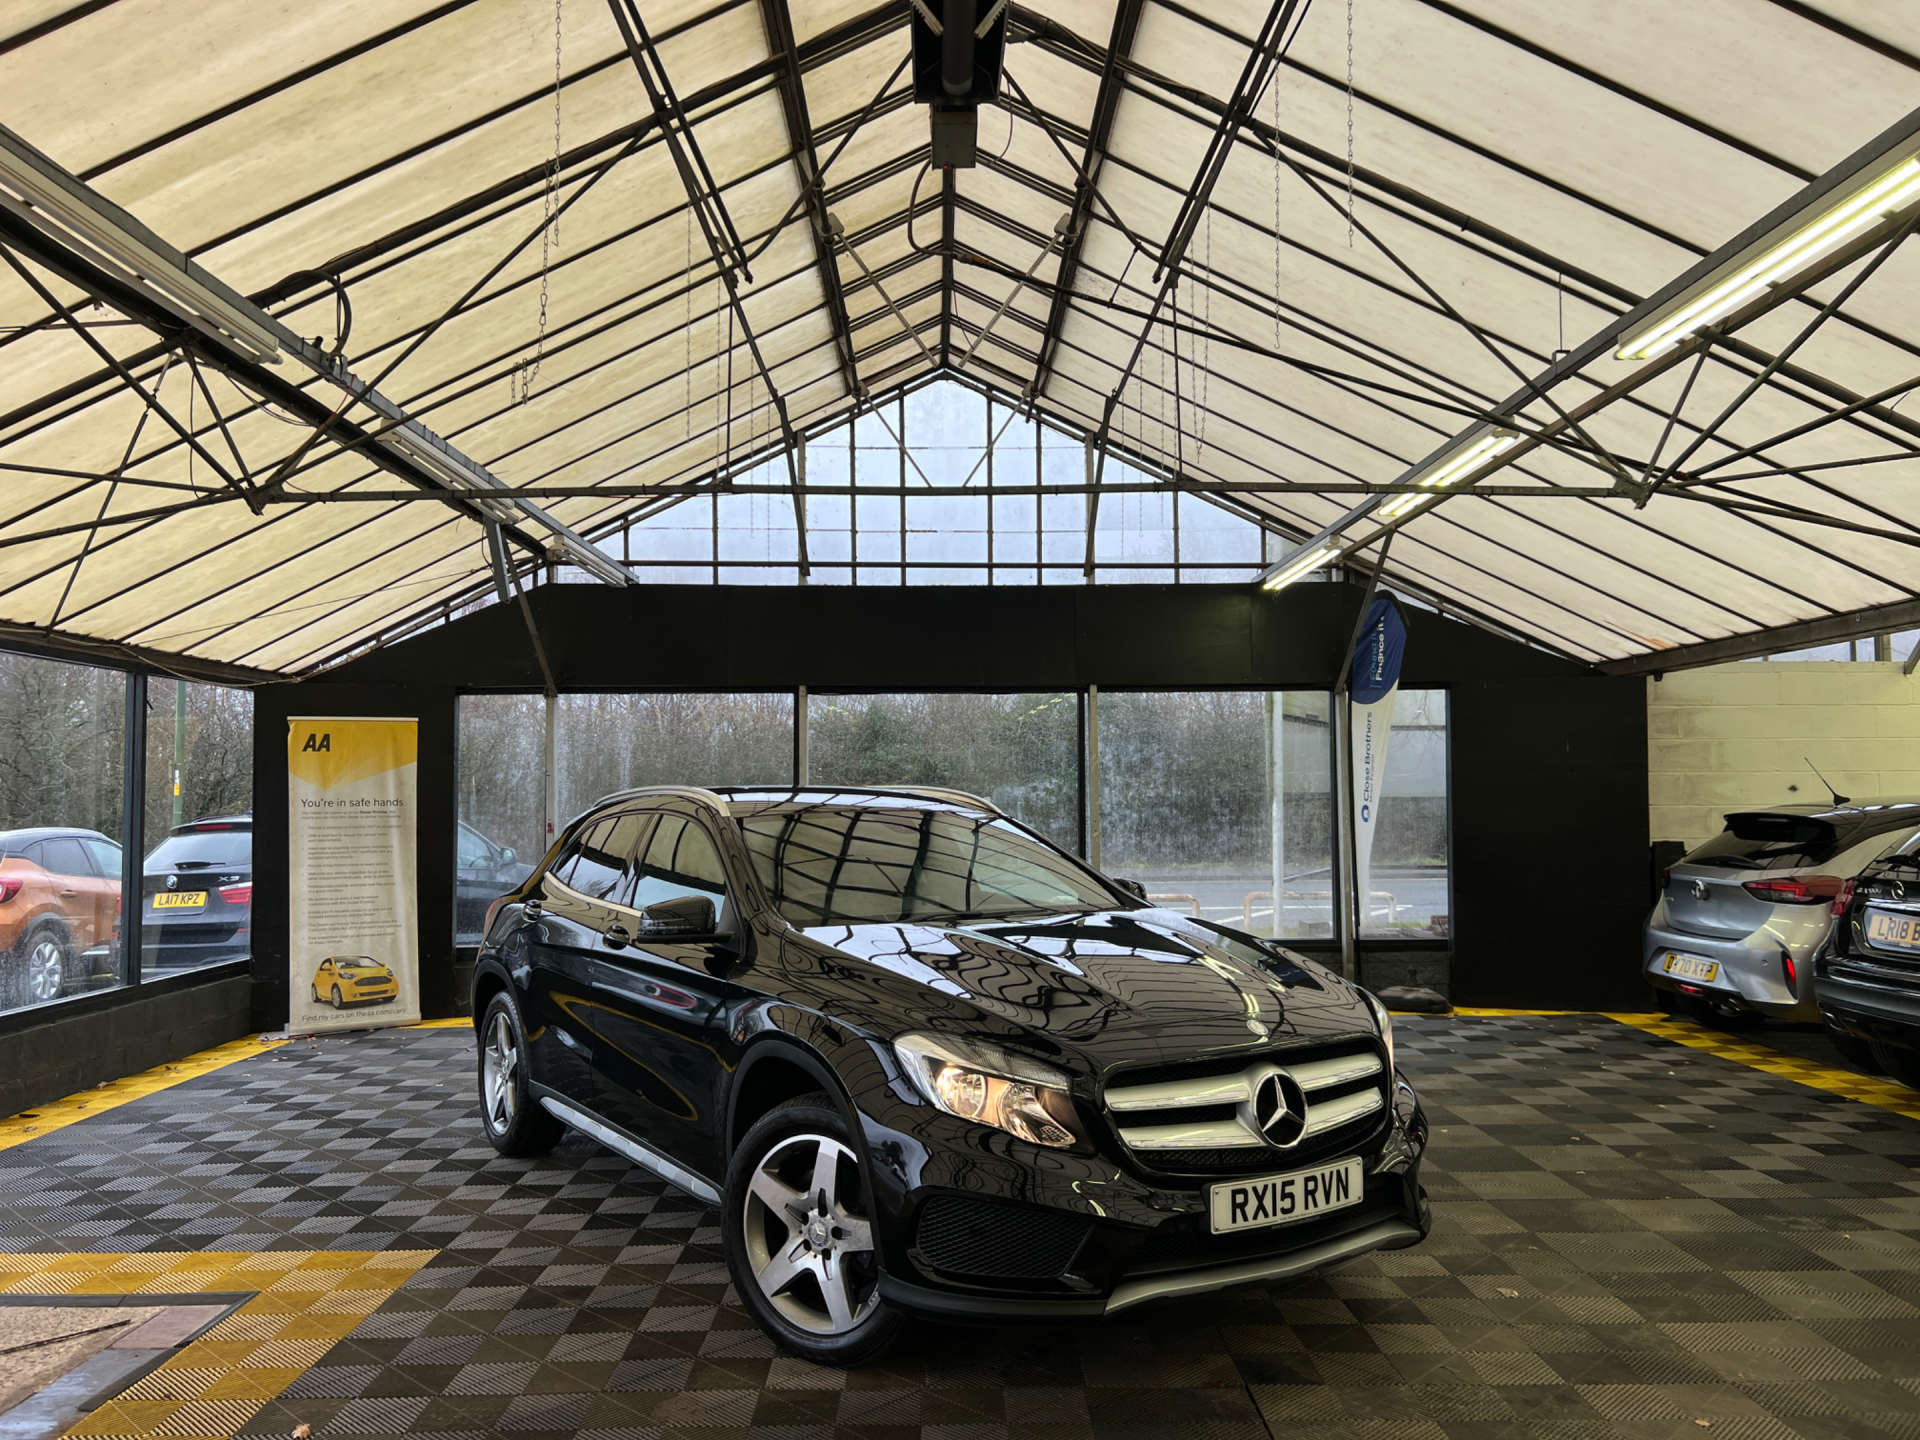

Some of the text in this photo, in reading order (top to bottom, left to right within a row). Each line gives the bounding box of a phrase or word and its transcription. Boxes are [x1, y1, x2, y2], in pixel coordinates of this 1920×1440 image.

[1375, 633, 1385, 680] Finance
[301, 733, 331, 752] AA
[1364, 711, 1373, 765] Brothers
[300, 797, 404, 808] You're in safe hands
[159, 893, 200, 906] LA17 KPZ
[1877, 918, 1910, 940] LR18
[1230, 1166, 1350, 1224] RX15 RVN
